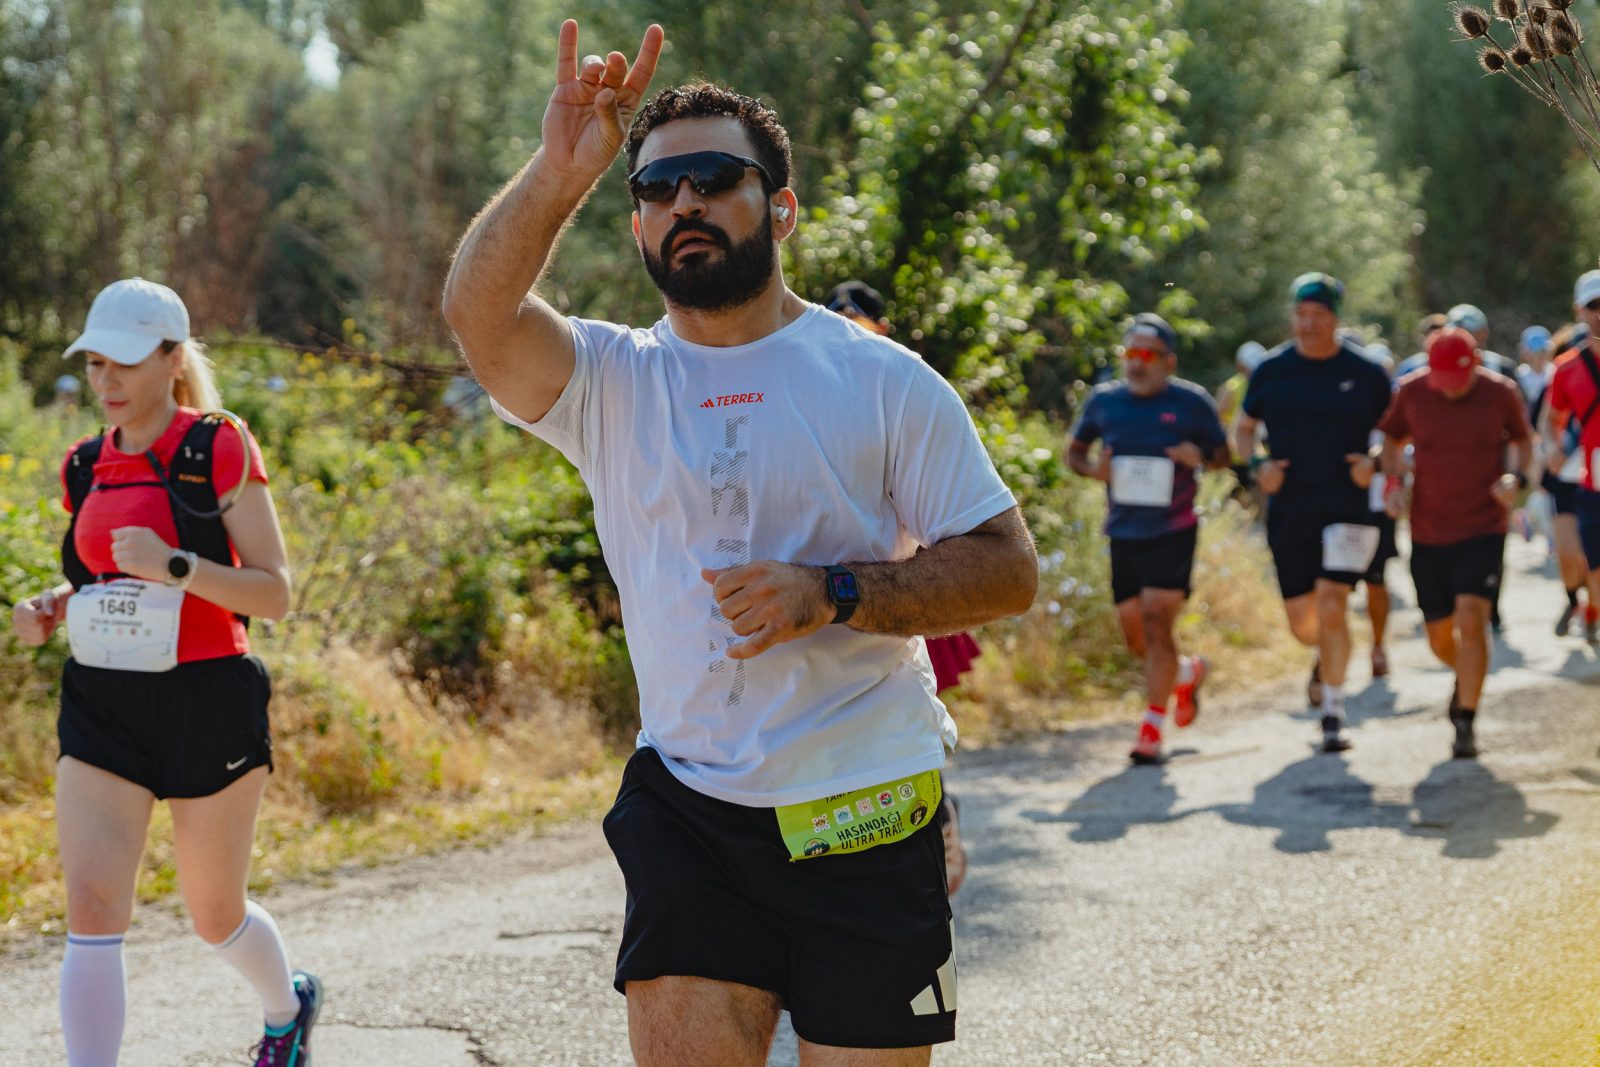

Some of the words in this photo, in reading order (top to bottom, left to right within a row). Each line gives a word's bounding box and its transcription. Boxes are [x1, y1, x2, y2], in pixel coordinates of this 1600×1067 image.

[716, 393, 764, 406] TERREX
[98, 598, 137, 615] 1649
[841, 834, 875, 849] ULTRA
